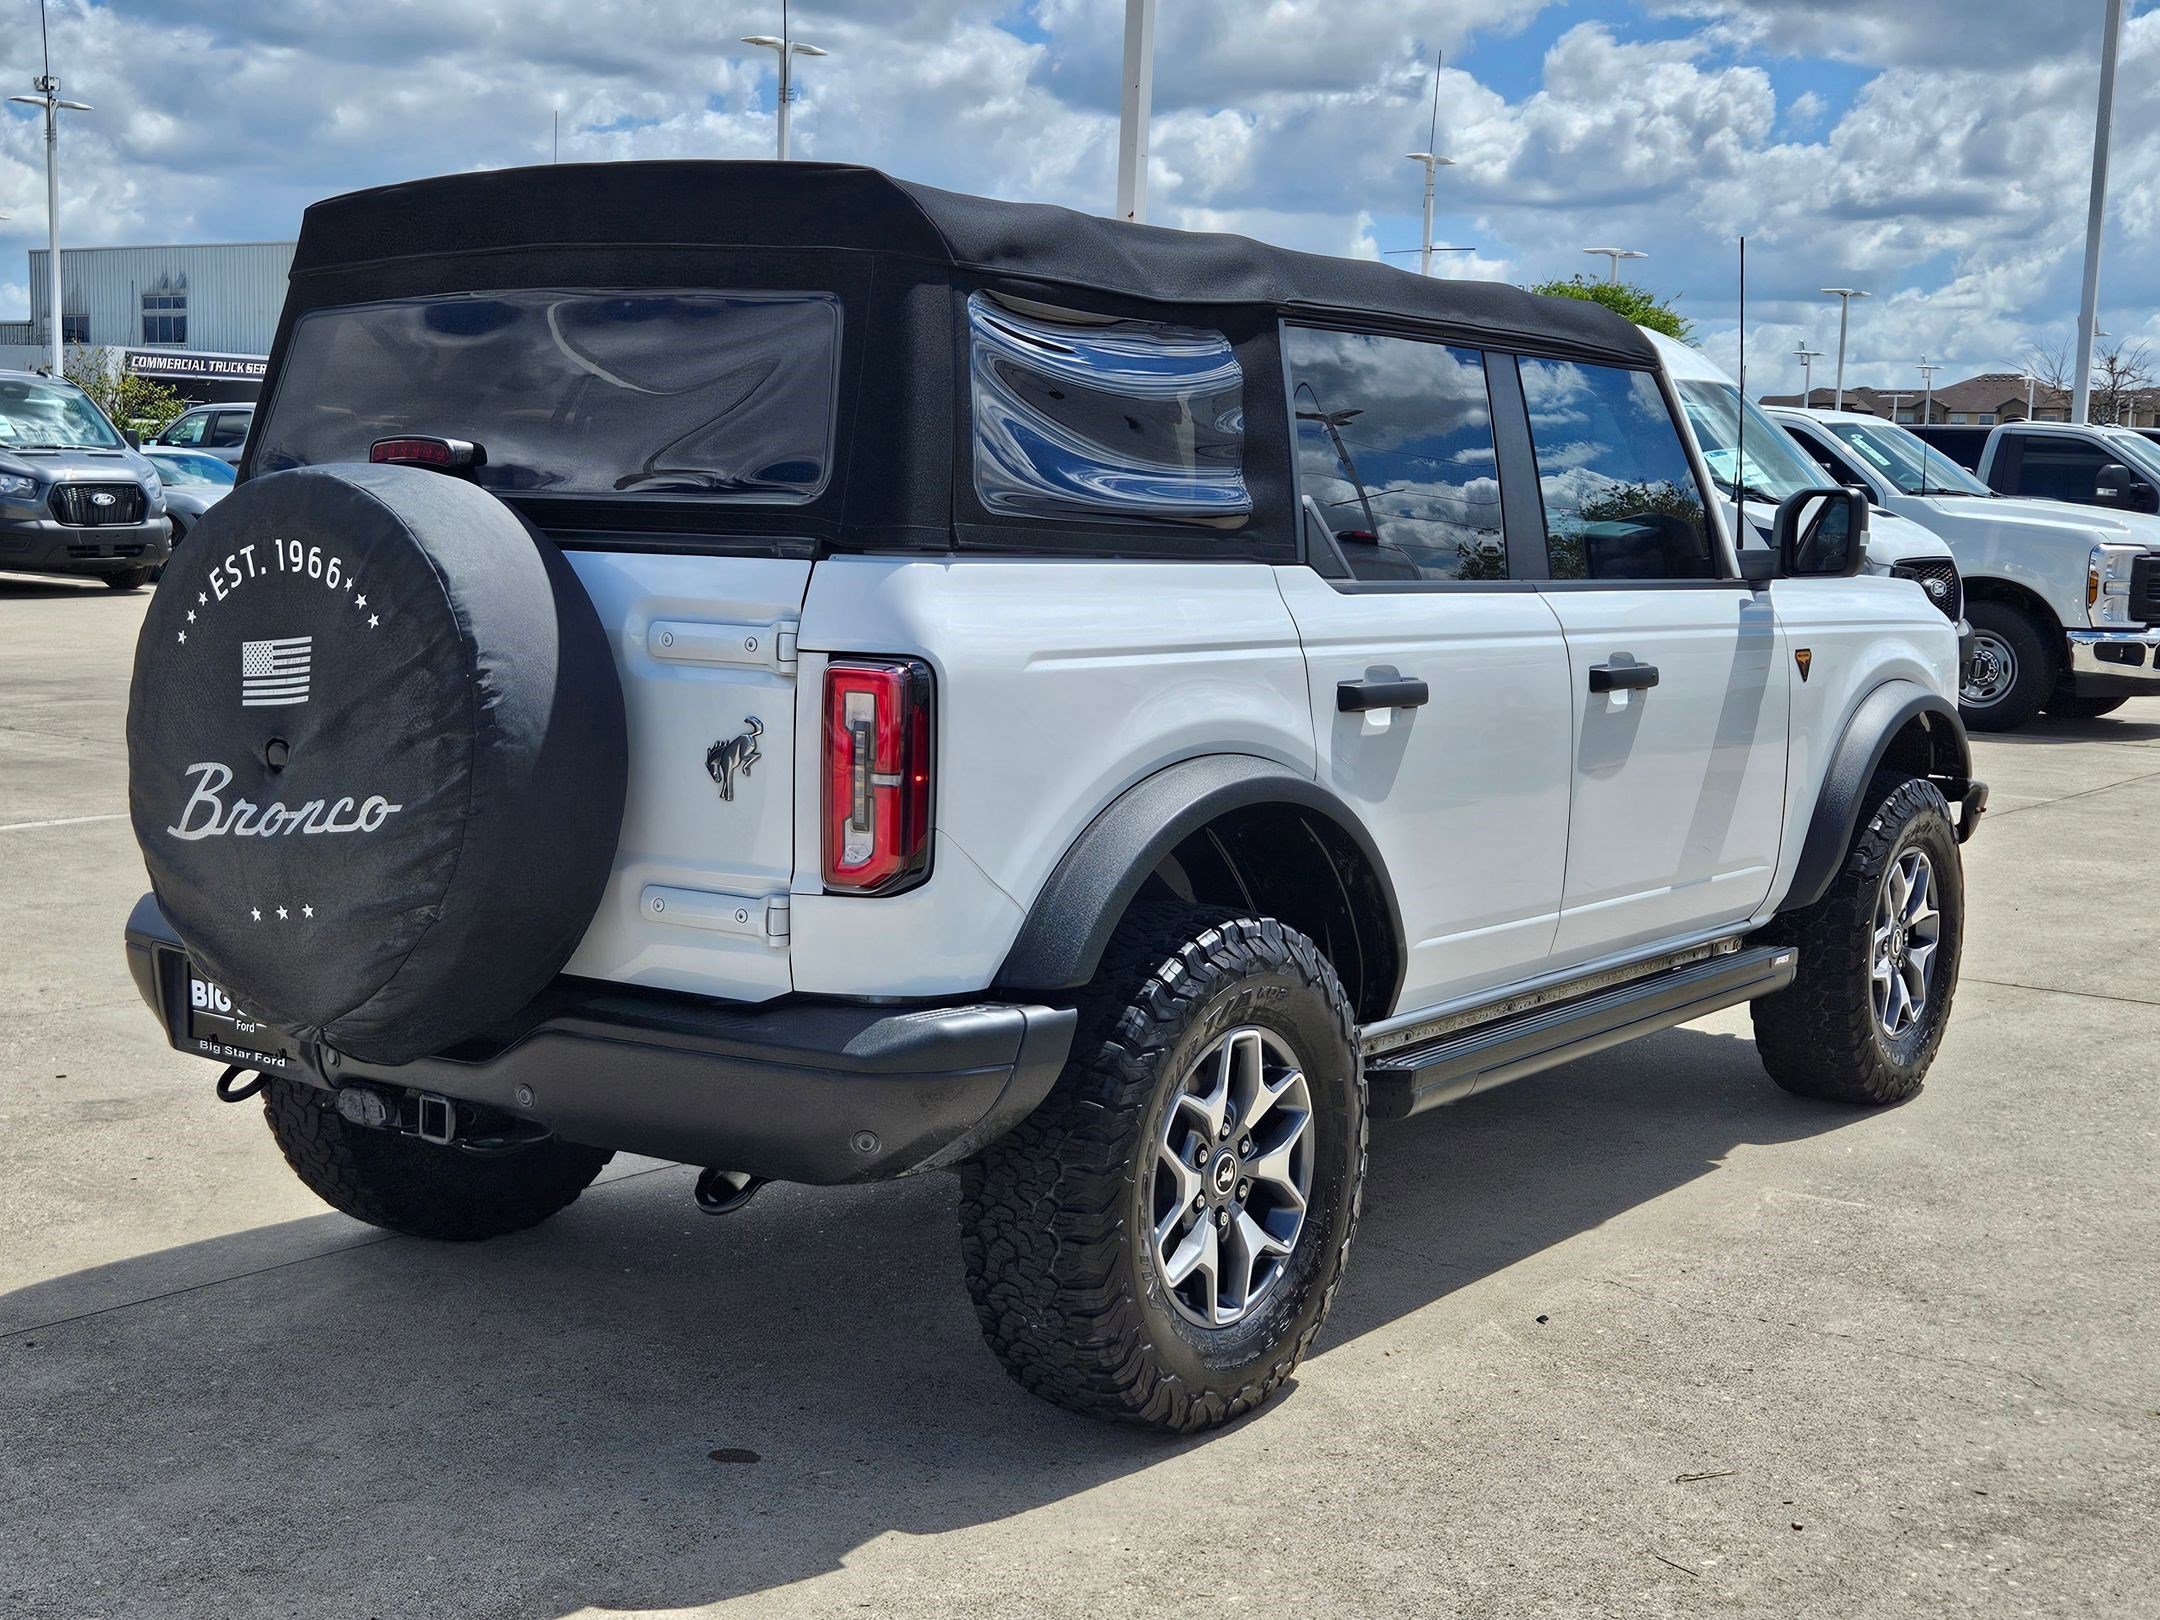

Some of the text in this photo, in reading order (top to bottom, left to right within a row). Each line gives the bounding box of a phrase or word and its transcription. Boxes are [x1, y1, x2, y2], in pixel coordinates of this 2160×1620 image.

[132, 356, 206, 371] COMMERCIAL
[209, 361, 245, 373] TRUCK
[209, 539, 342, 601] EST. 1966
[167, 762, 403, 841] Bronco
[191, 979, 232, 1012] BIG
[236, 1020, 255, 1033] Ford
[200, 1040, 286, 1067] Big Star Ford
